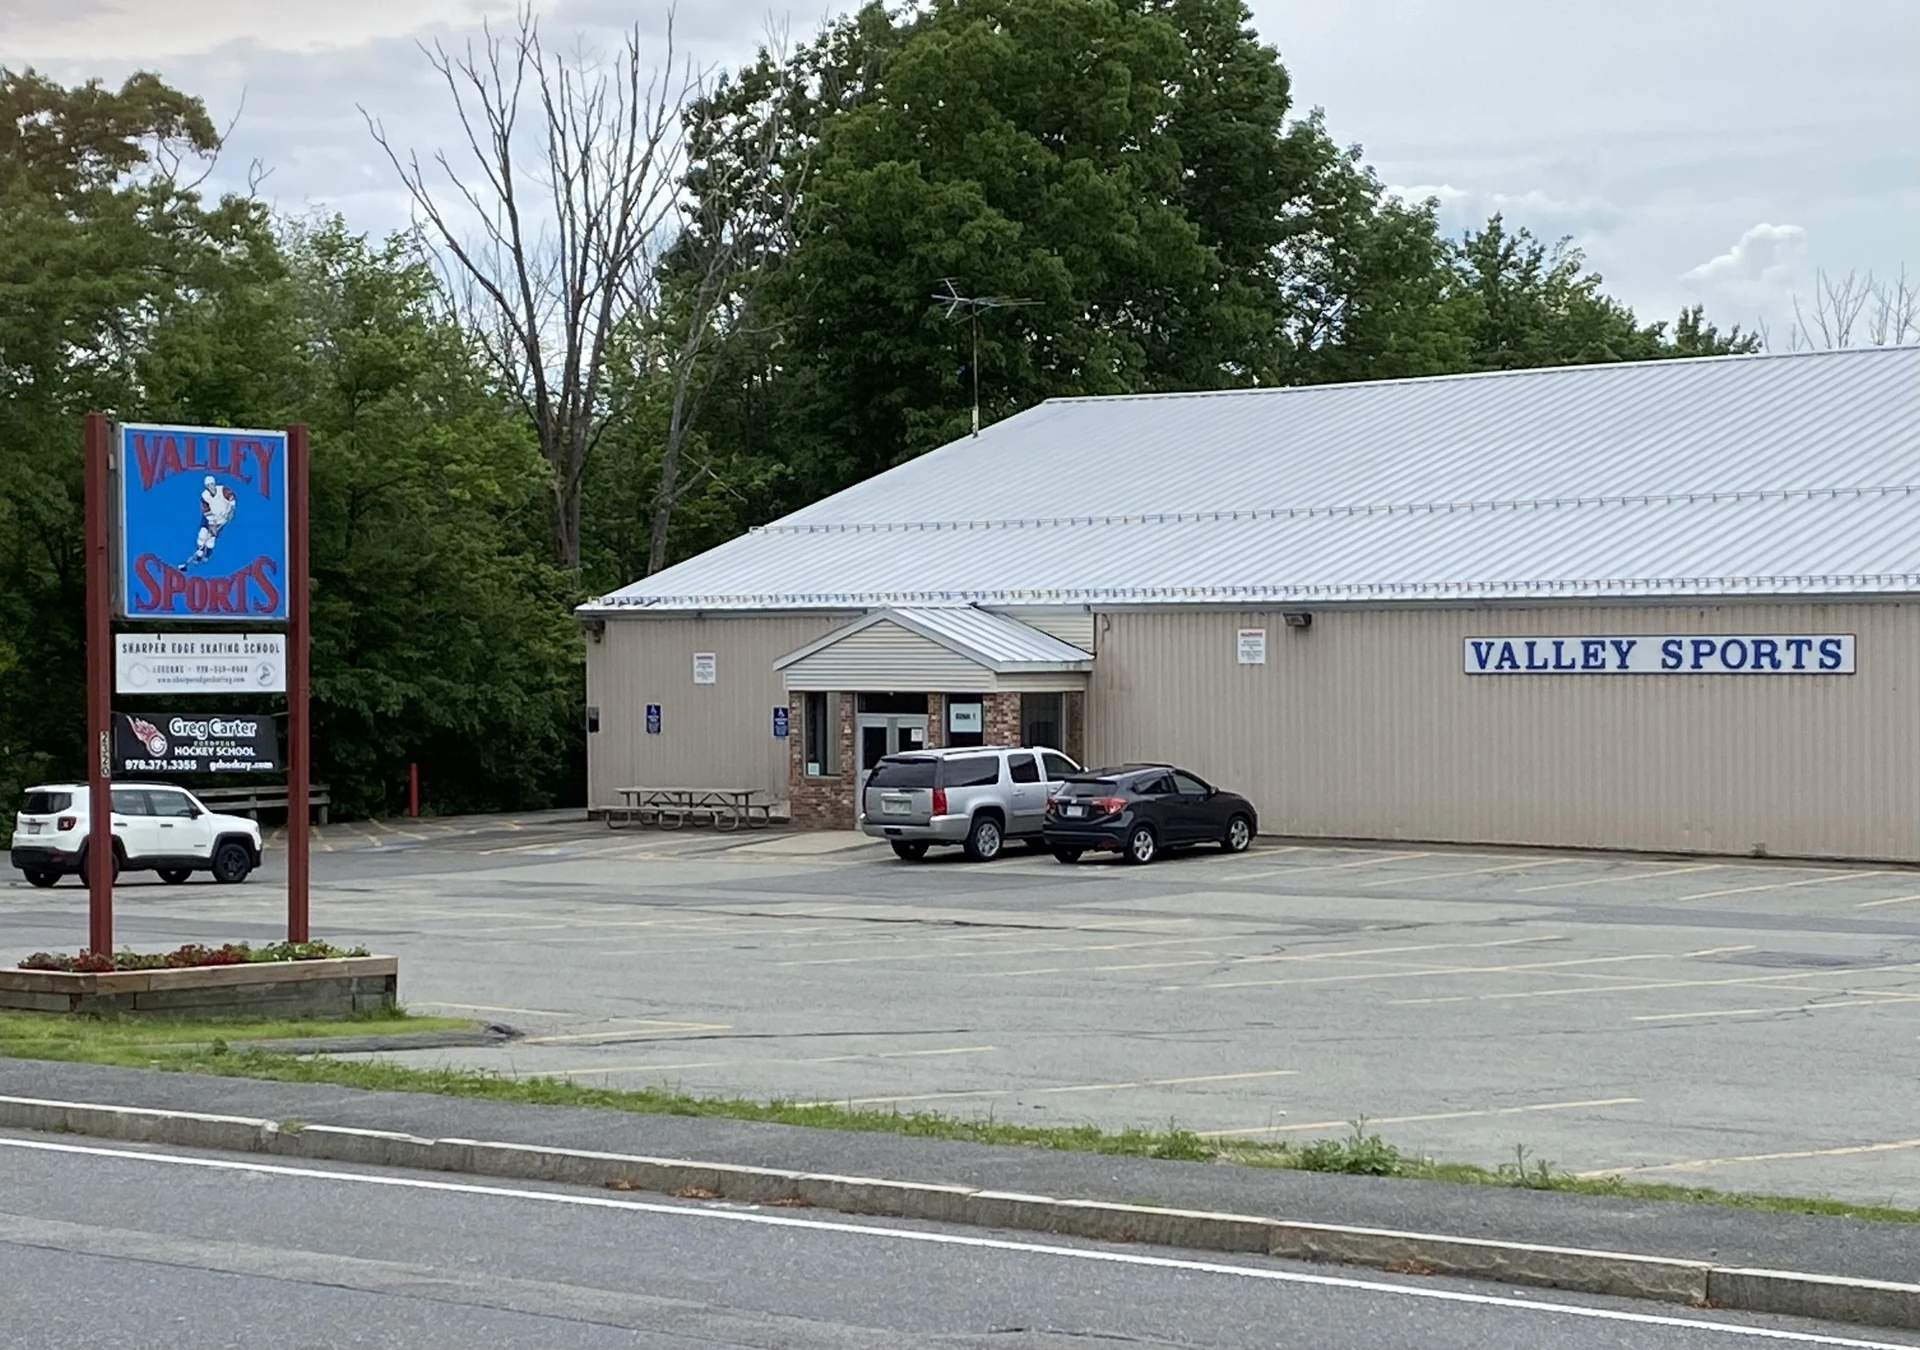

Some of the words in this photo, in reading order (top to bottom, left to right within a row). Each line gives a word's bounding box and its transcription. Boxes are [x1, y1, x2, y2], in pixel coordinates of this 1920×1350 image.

[132, 433, 277, 500] VALLEY
[133, 552, 280, 615] SPORTS
[121, 642, 167, 654] SHARPER
[171, 642, 196, 654] EDGE
[200, 642, 240, 654] SKATING
[244, 642, 280, 654] SCHOOL
[1470, 639, 1638, 670] VALLEY
[1660, 638, 1843, 670] SPORTS
[168, 717, 209, 740] Greg
[208, 717, 258, 738] Carter
[174, 746, 215, 757] HOCKEY
[216, 746, 257, 757] SCHOOL
